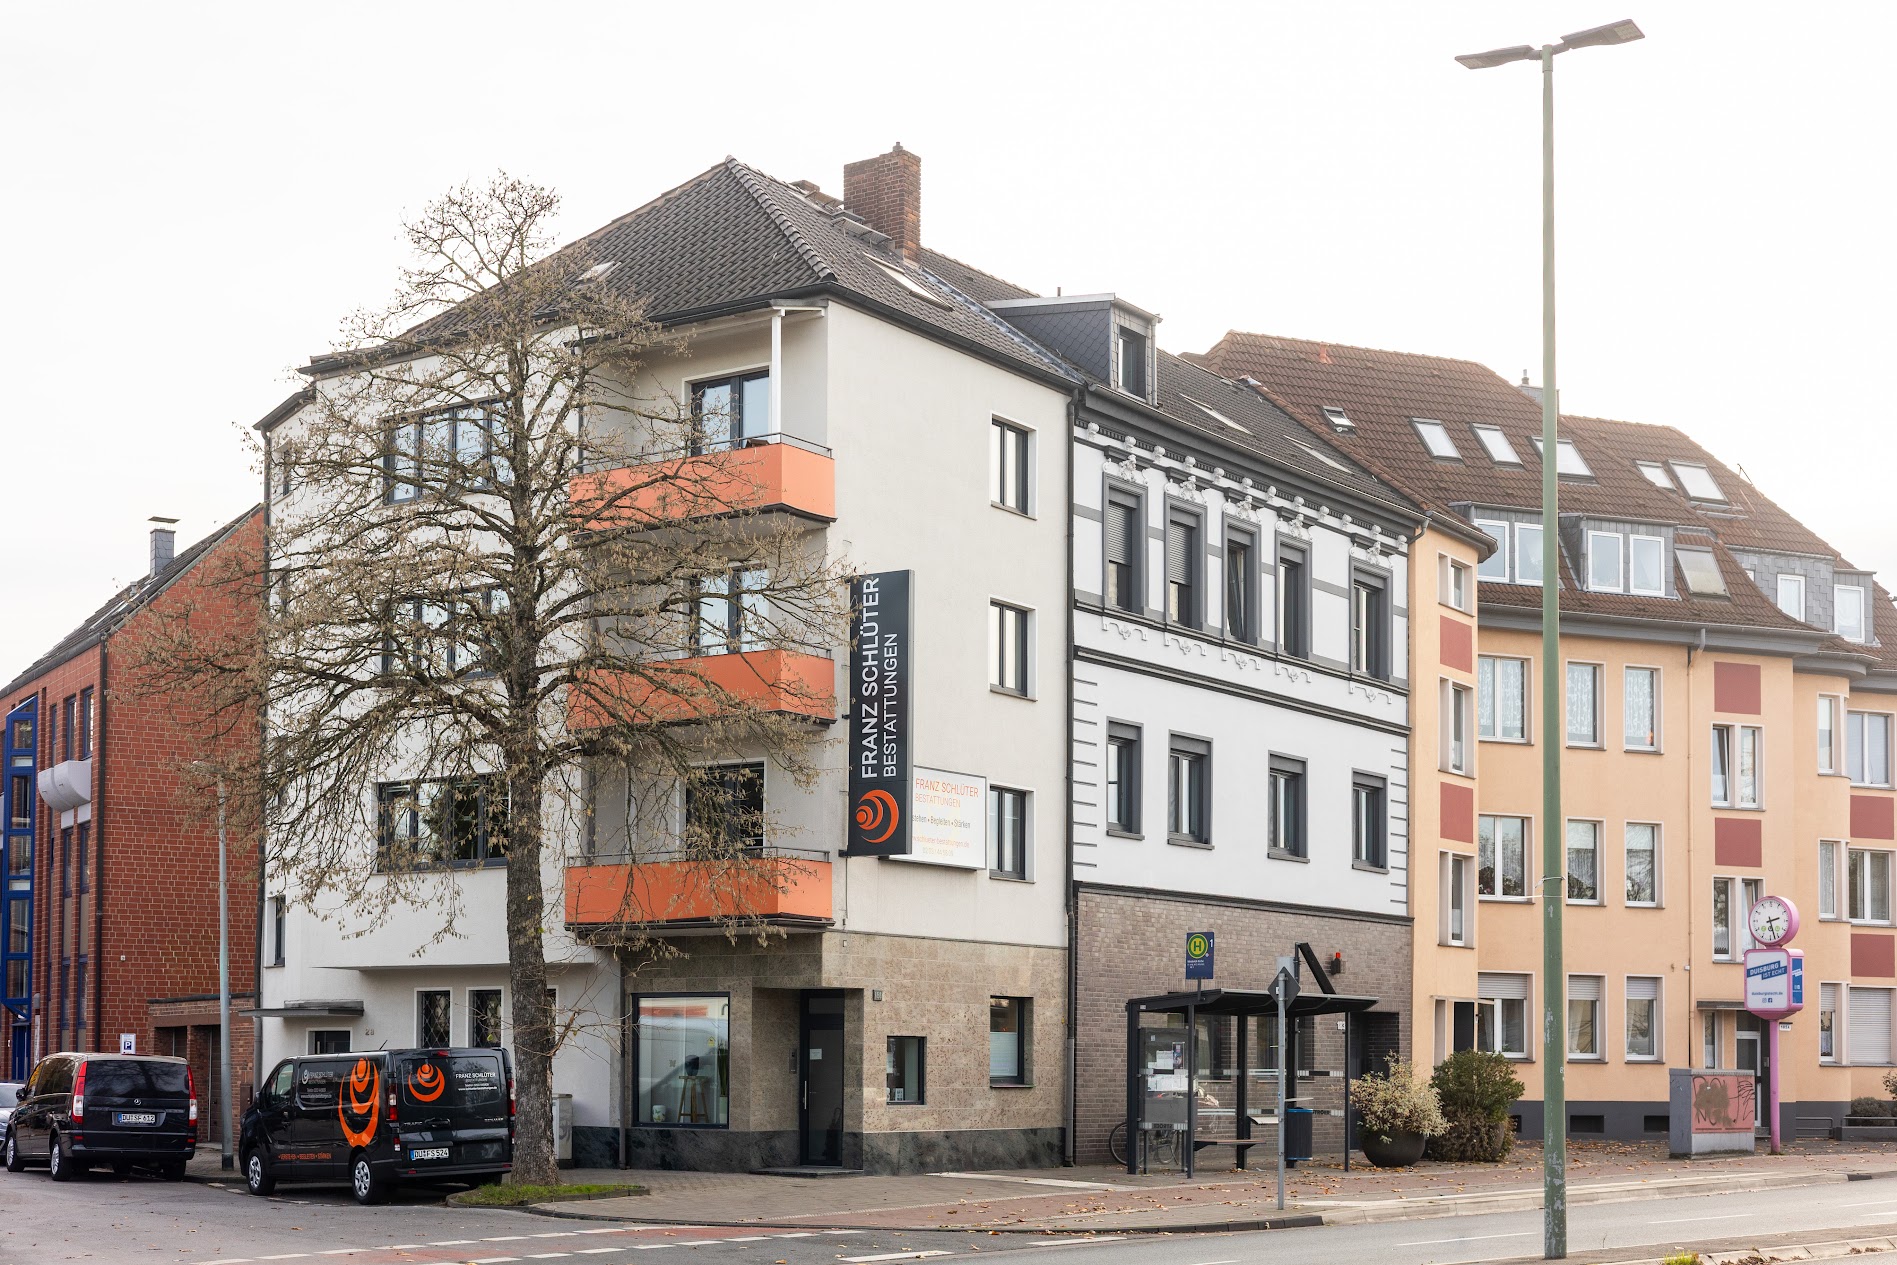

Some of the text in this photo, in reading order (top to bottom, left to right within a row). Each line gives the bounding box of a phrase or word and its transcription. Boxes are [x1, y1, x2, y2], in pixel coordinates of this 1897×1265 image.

[860, 577, 880, 779] FRANZ SCHLÜTER
[883, 633, 898, 777] BESTATTUNGEN
[915, 778, 979, 798] FRANZ SCHLÜTER
[915, 792, 961, 808] BESTATTUNGEN
[930, 815, 951, 827] Begleiten
[953, 818, 971, 829] Stärken
[1193, 940, 1202, 951] H
[1209, 939, 1213, 948] 1
[1749, 963, 1779, 976] DUISBURG
[1771, 968, 1785, 976] ECHT
